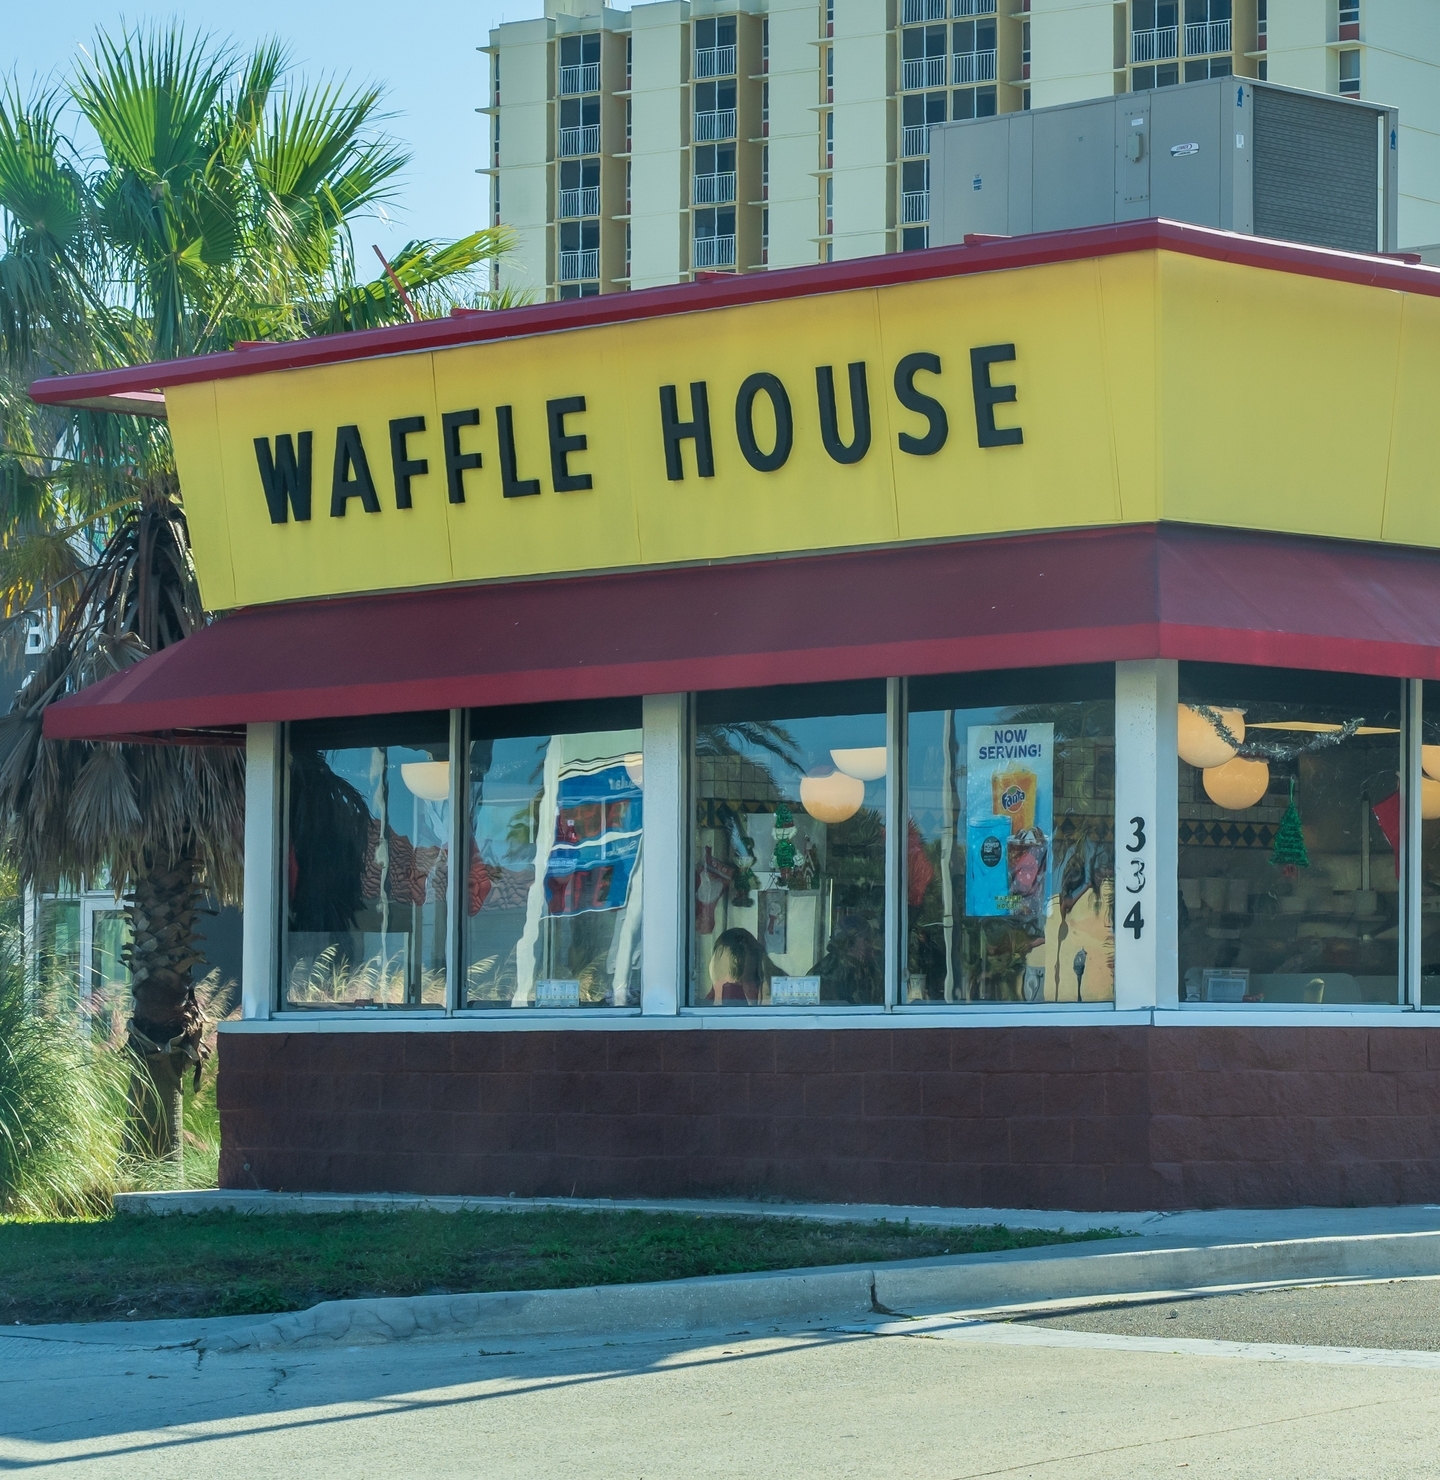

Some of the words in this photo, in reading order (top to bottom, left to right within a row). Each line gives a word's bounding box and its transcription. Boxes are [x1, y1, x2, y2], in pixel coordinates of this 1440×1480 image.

[253, 395, 593, 524] WAFFLE
[659, 343, 1024, 481] HOUSE
[994, 729, 1027, 744] NOW
[979, 744, 1042, 760] SERVING!
